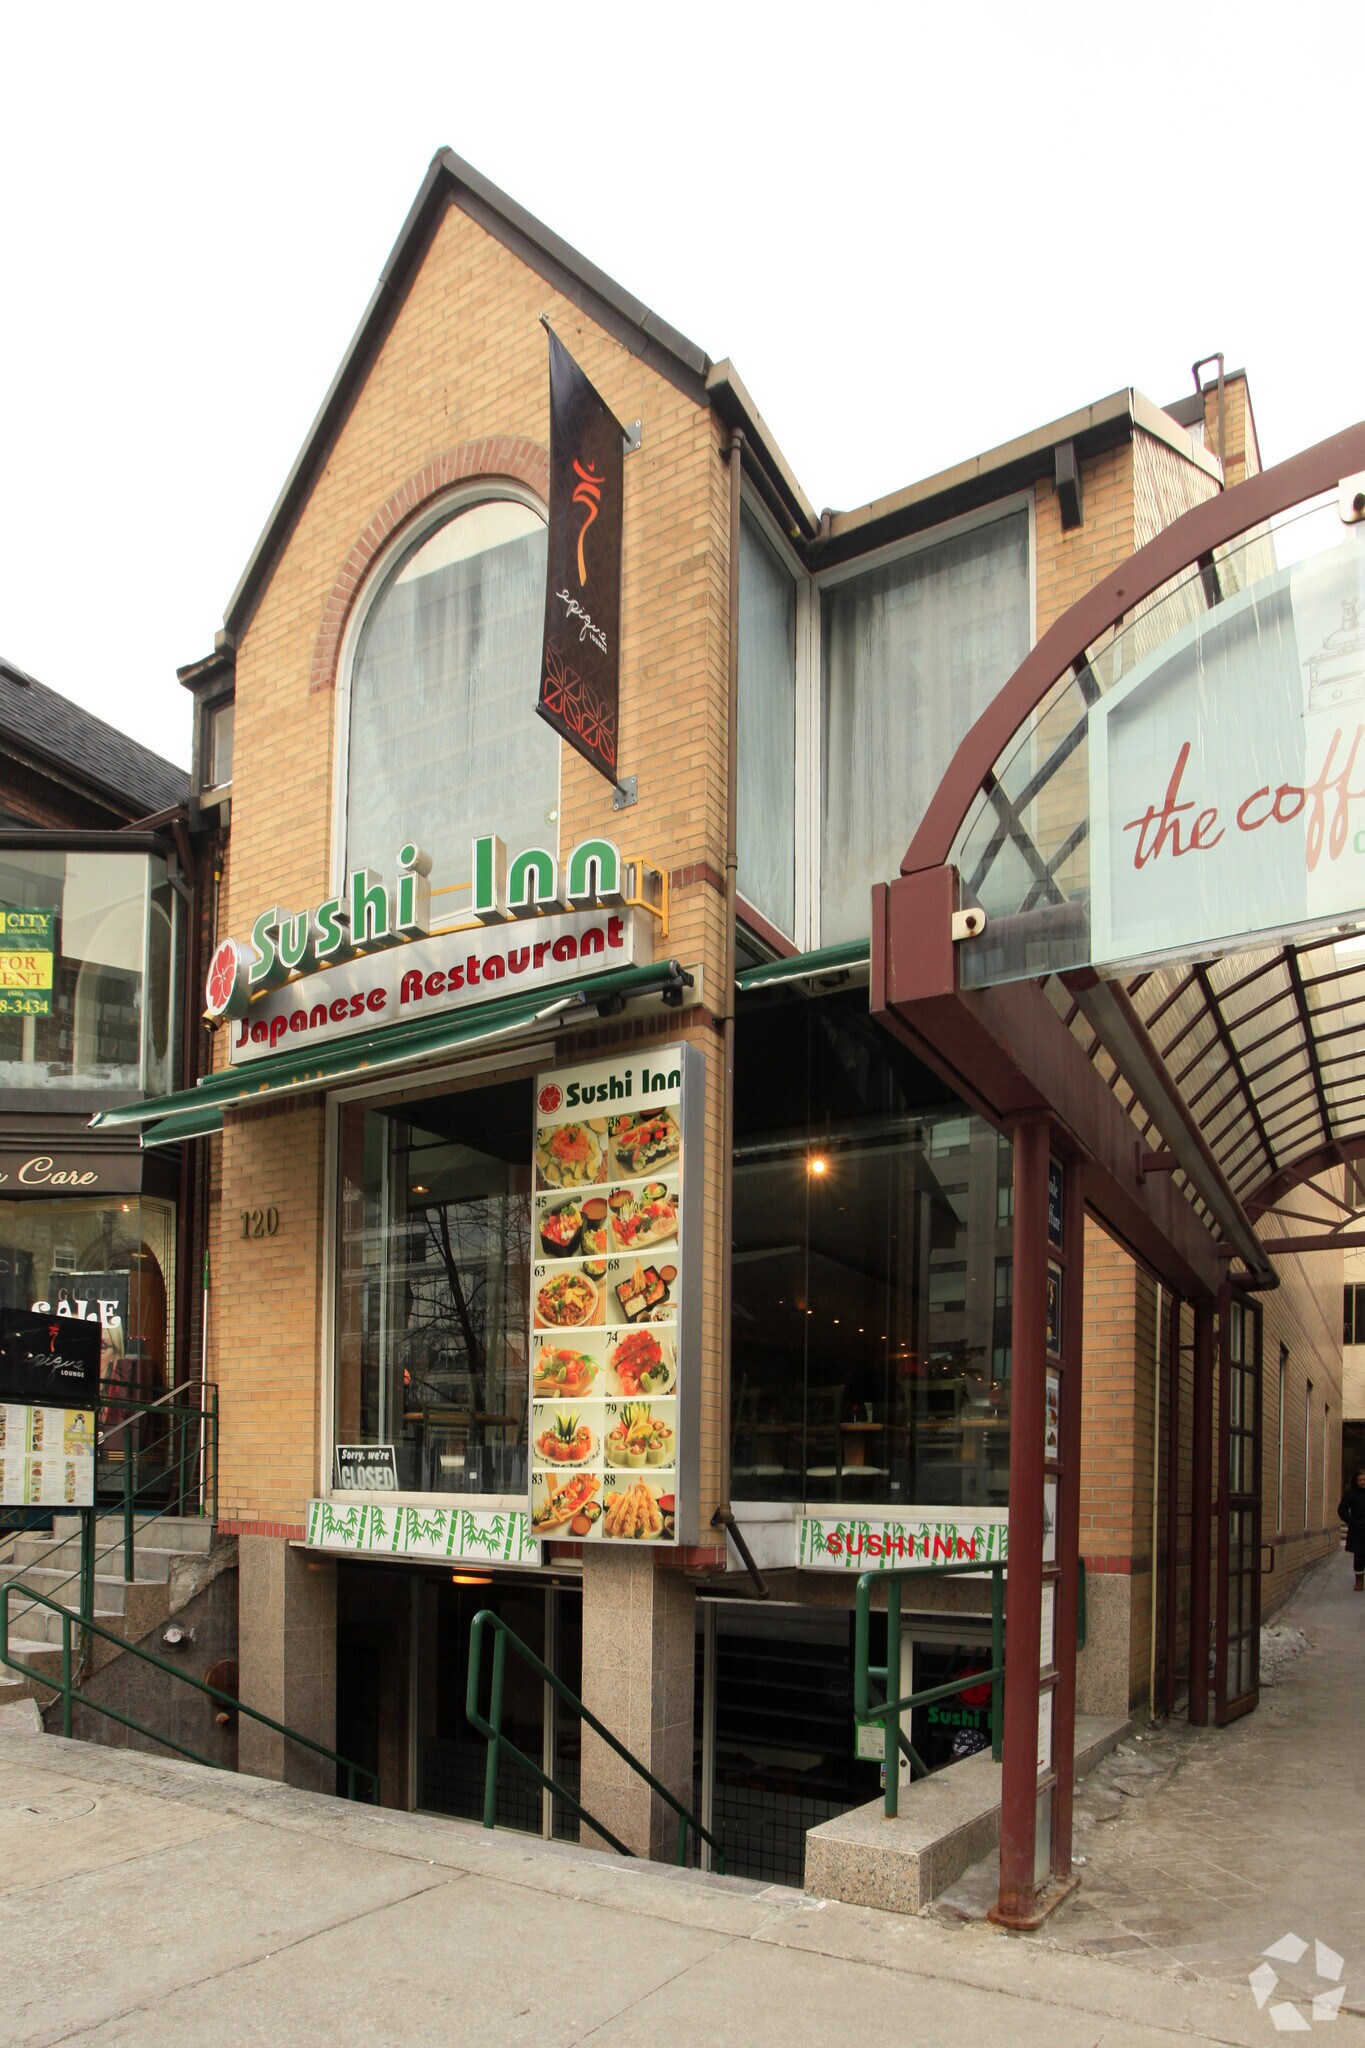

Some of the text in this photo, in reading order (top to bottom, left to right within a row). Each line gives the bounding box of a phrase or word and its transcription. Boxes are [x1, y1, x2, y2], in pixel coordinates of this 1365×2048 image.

[1123, 742, 1226, 870] the
[249, 833, 621, 986] Sushi Inn
[6, 913, 50, 927] CITY
[236, 914, 625, 1047] Japanese Restaurant
[566, 1069, 681, 1108] Sushi Inn
[18, 1156, 99, 1185] Care
[535, 1196, 547, 1208] 45
[240, 1206, 279, 1239] 120
[534, 1265, 546, 1277] 63
[608, 1258, 620, 1271] 68
[533, 1335, 544, 1347] 71
[606, 1331, 618, 1343] 74
[60, 1369, 85, 1378] LOUNGE
[532, 1404, 544, 1416] 77
[605, 1403, 617, 1415] 79
[341, 1449, 390, 1462] Sorry, we're
[341, 1466, 394, 1491] CLOSED
[531, 1473, 543, 1485] 83
[603, 1474, 616, 1486] 88
[826, 1532, 976, 1559] SUSHI INN
[928, 1706, 980, 1728] Sushi
